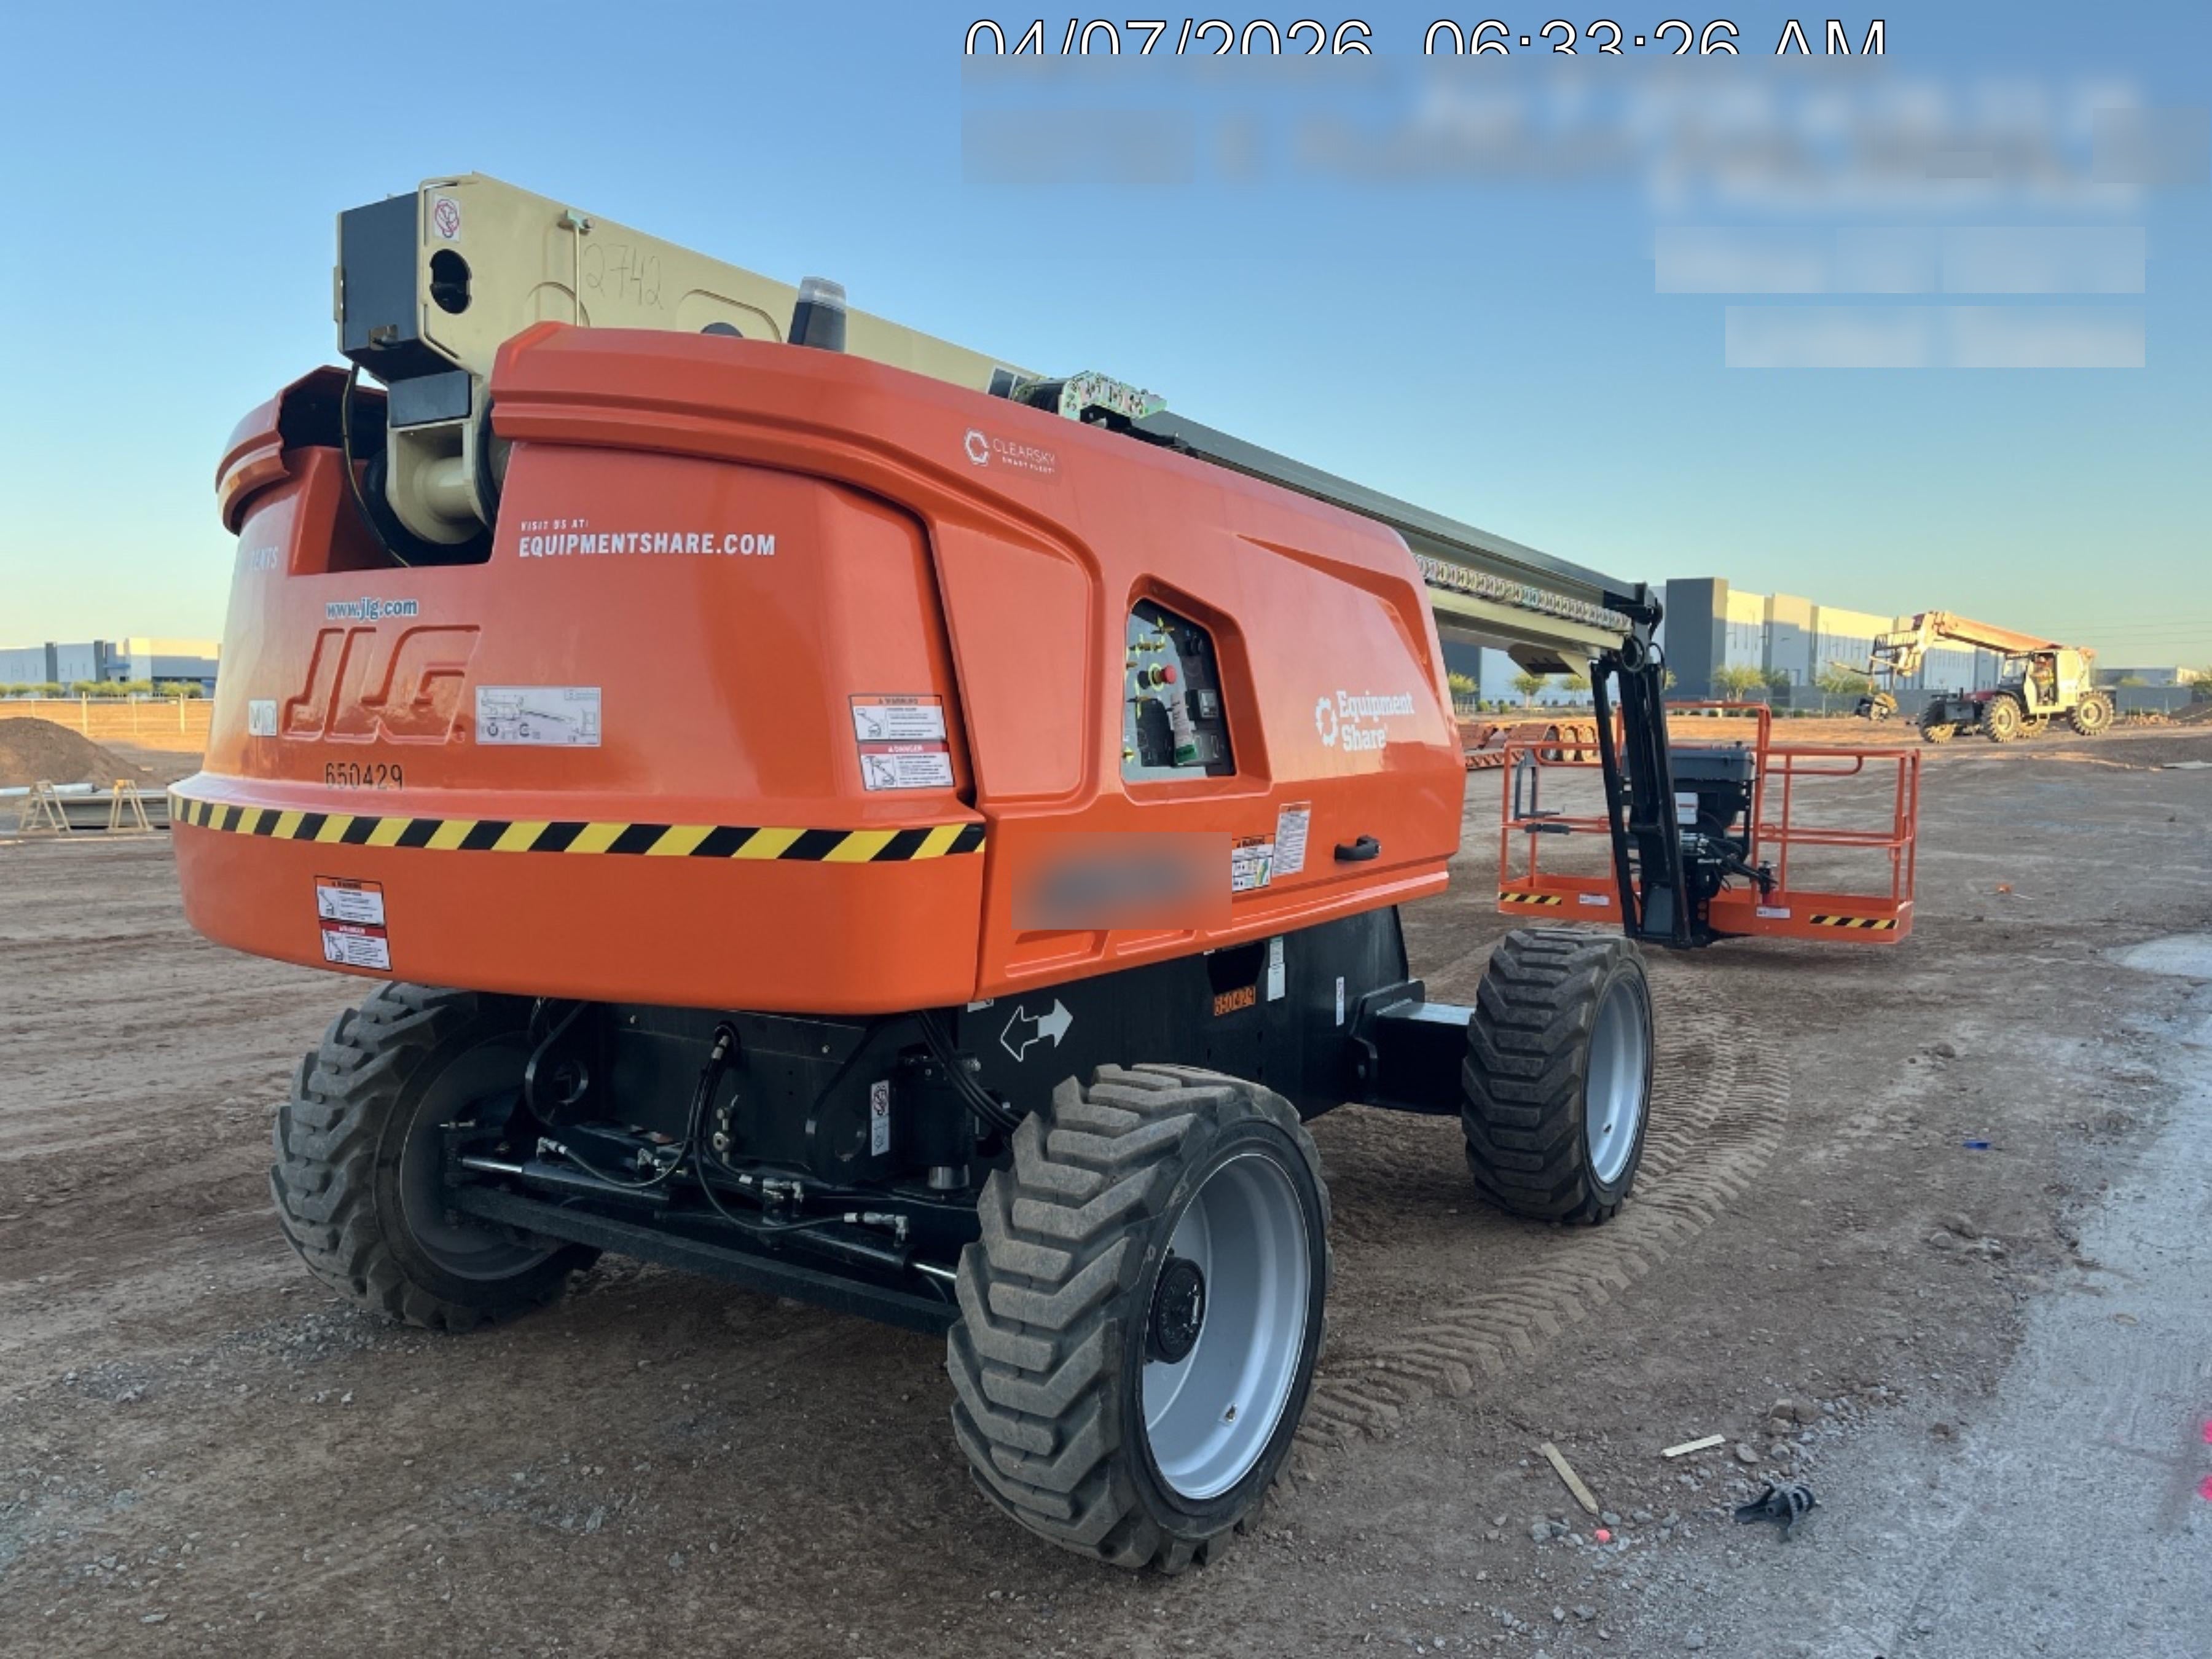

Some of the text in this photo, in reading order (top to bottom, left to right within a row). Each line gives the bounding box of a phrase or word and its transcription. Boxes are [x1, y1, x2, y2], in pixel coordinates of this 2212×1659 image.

[584, 243, 664, 310] 2742
[993, 438, 1055, 464] CLEARSKY
[521, 520, 548, 531] VISIT
[554, 519, 567, 530] US
[519, 532, 775, 557] EQUIPMENTSHARE.COM
[326, 597, 419, 623] www.jlg.com
[1336, 689, 1415, 724] Equipment
[1341, 724, 1387, 752] Share
[326, 762, 403, 790] 650429
